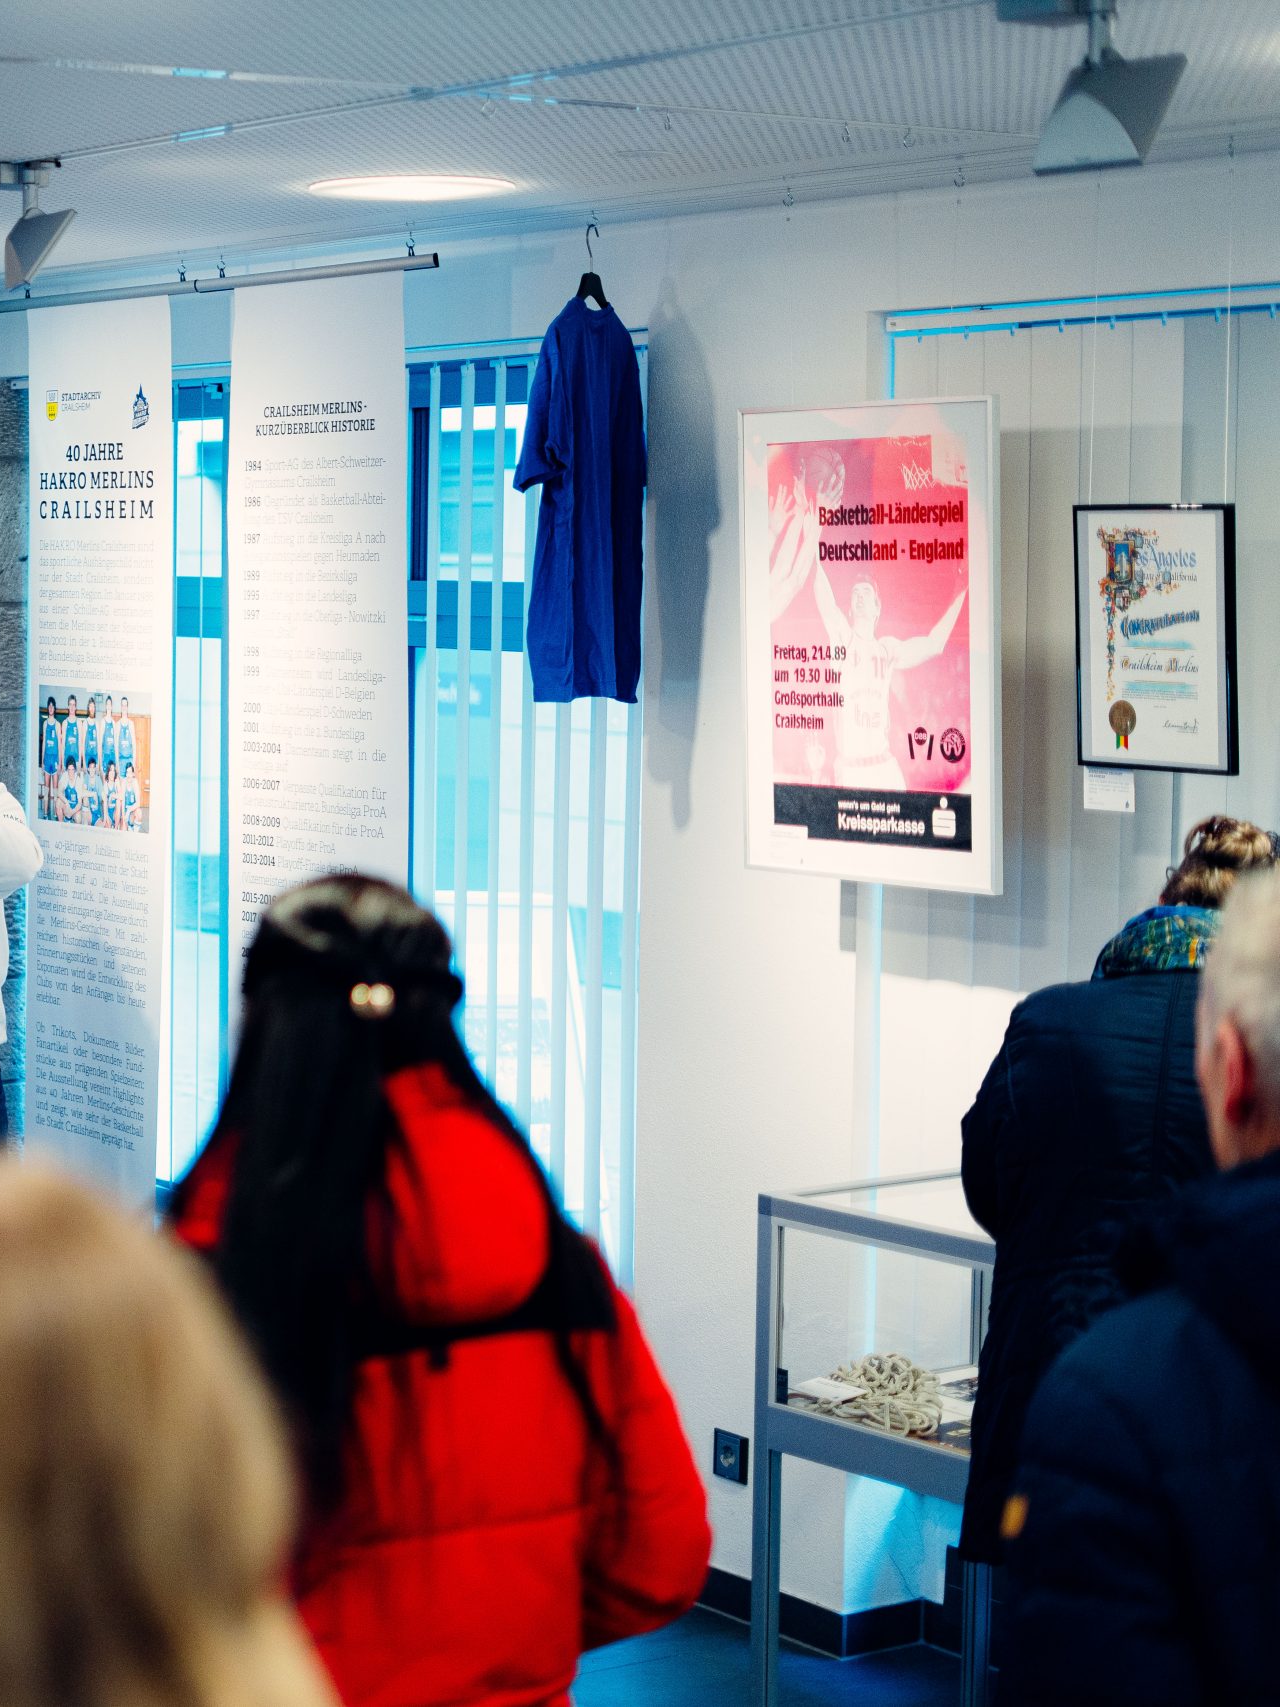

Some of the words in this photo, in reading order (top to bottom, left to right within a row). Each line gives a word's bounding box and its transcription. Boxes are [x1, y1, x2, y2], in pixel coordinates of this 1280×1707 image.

[61, 391, 101, 402] STADTARCHIV
[263, 402, 320, 419] CRAILSHEIM
[321, 400, 363, 416] MERLINS
[255, 421, 330, 437] KURZÜBERBLICK
[331, 418, 376, 433] HISTORIE
[66, 444, 80, 462] 40
[83, 443, 124, 462] JAHRE
[245, 460, 262, 472] 1984
[40, 471, 86, 490] HAKRO
[90, 470, 154, 489] MERLINS
[39, 500, 154, 519] CRAILSHEIM
[244, 496, 261, 508] 1986
[819, 500, 965, 527] Basketball-Länderspiel
[244, 533, 261, 545] 1987
[364, 530, 387, 544] nach
[819, 539, 898, 562] Deutschland
[909, 538, 965, 563] England
[774, 645, 810, 662] Freitag,
[811, 646, 847, 661] 21.4.89
[774, 670, 789, 683] um
[794, 669, 820, 684] 19.30
[824, 669, 842, 684] Uhr
[774, 690, 845, 708] Großsporthalle
[243, 702, 261, 714] 2000
[775, 713, 824, 730] Crailsheim
[372, 748, 387, 762] die
[242, 777, 281, 791] 2006-2007
[372, 786, 388, 800] für
[363, 804, 388, 819] ProA
[870, 802, 886, 812] Geld
[886, 803, 901, 814] geht
[242, 813, 281, 828] 2008-2009
[360, 825, 385, 839] ProA
[837, 812, 926, 835] Kreissparkasse
[242, 833, 275, 847] 2011-2012
[242, 852, 276, 867] 2013-2014
[241, 910, 257, 923] 2017
[36, 1036, 69, 1054] Fanartikel
[73, 1045, 88, 1058] oder
[92, 1048, 123, 1068] besondere
[59, 1059, 71, 1070] aus
[35, 1066, 47, 1080] Die
[48, 1070, 88, 1092] Ausstellung
[35, 1084, 47, 1095] aus
[35, 1100, 49, 1112] und
[35, 1112, 46, 1126] die
[65, 1119, 101, 1140] Crailsheim
